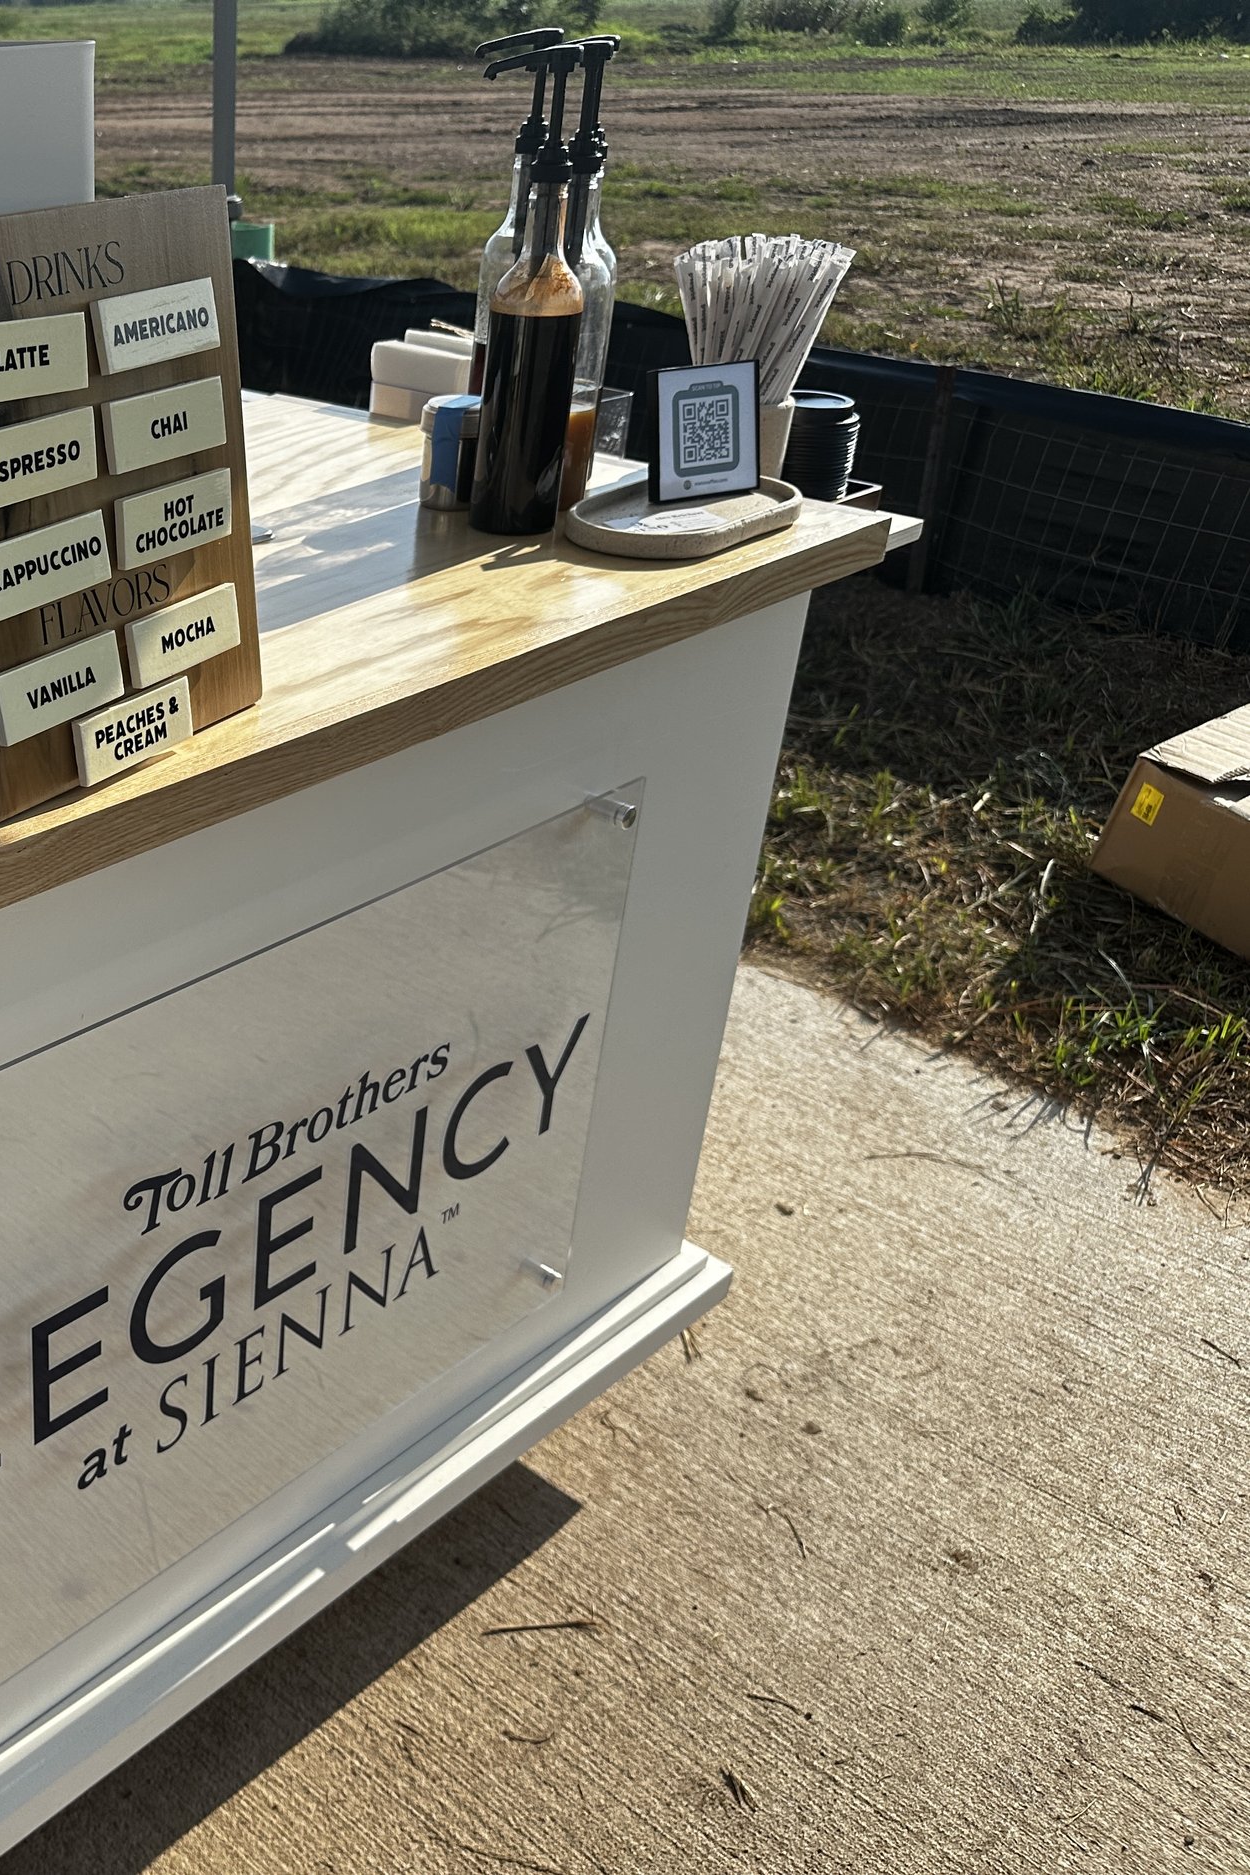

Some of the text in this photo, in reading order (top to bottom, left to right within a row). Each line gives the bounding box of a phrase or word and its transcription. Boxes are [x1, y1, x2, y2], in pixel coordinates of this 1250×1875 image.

[5, 240, 126, 306] DRINKS
[112, 306, 210, 347] AMERICANO
[150, 411, 189, 440] CHAI
[135, 507, 225, 553] CHOCOLATE
[163, 494, 195, 521] HOT
[39, 563, 171, 645] FLAVORS
[161, 616, 216, 654] MOCHA
[27, 666, 97, 710] VANILLA
[94, 695, 180, 749] PEACHES &
[114, 721, 168, 761] CREAM
[123, 1041, 451, 1236] Toll Brothers
[76, 1203, 460, 1491] at SIENNA TM
